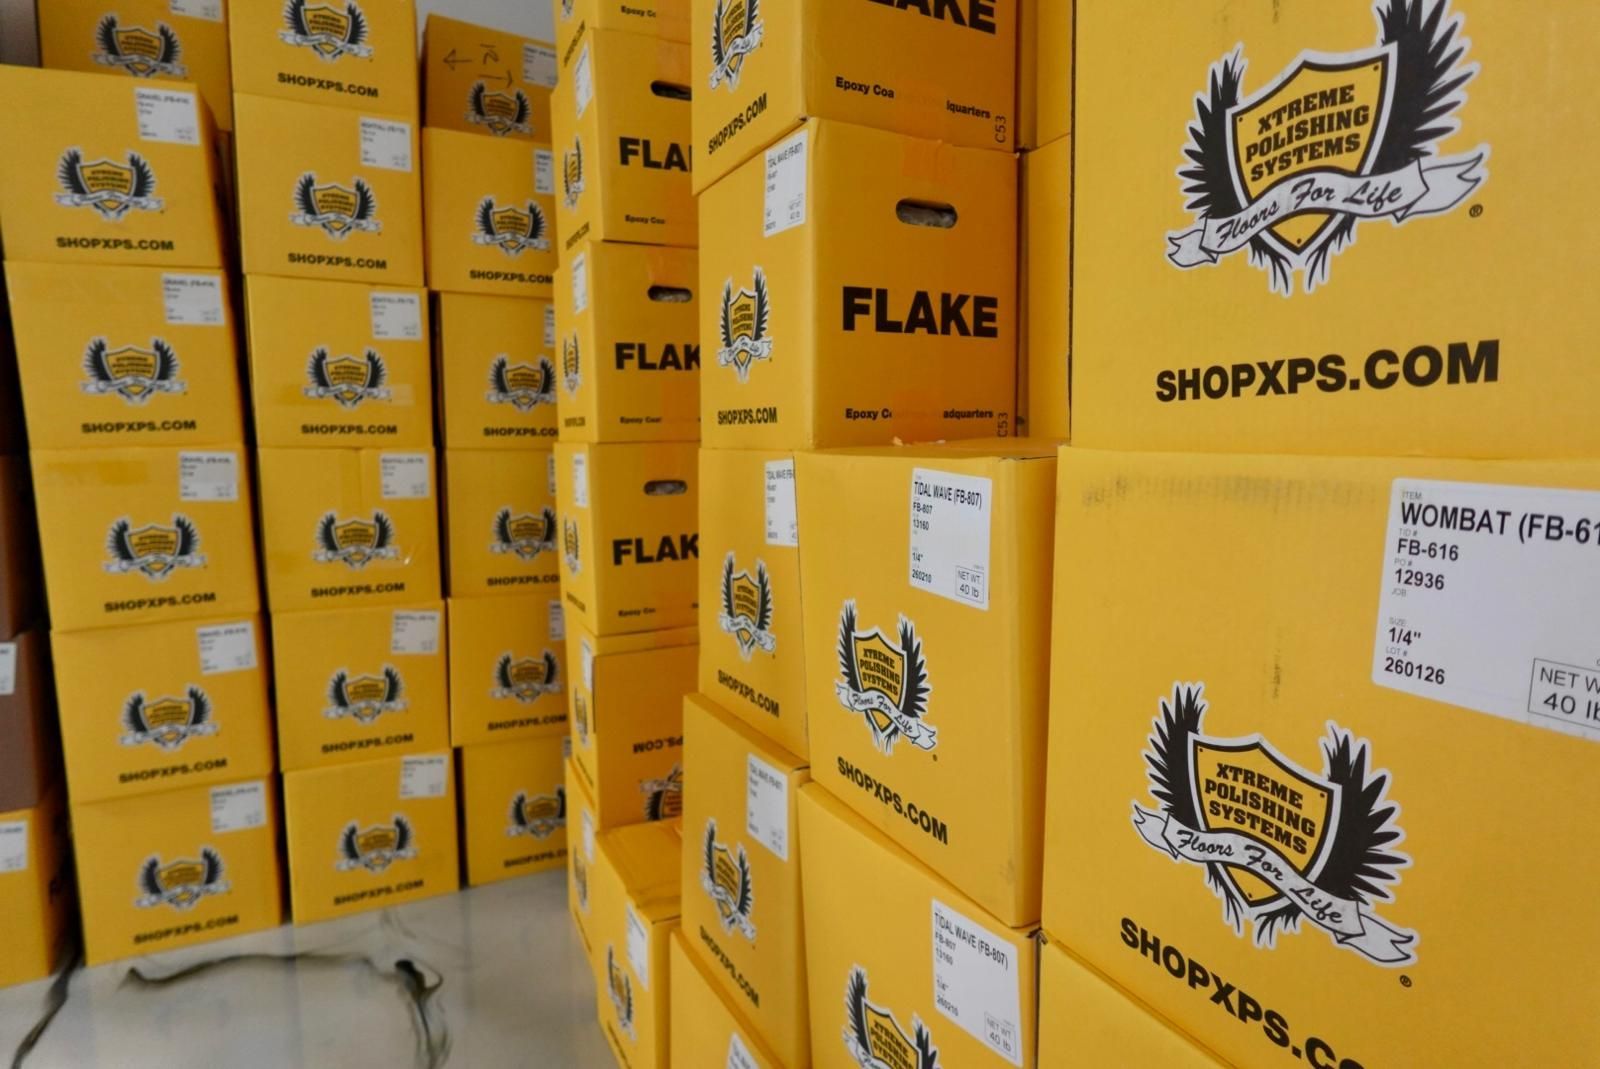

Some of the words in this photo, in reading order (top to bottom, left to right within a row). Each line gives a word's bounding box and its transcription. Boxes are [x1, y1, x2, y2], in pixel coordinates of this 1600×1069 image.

[277, 72, 379, 98] SHOPXPS.COM
[835, 76, 870, 95] Epoxy
[873, 84, 895, 99] Coa
[1257, 84, 1355, 135] XTREME
[708, 92, 767, 155] SHOPXPS.COM
[994, 115, 1007, 144] C53
[1245, 104, 1370, 163] POLISHING
[618, 136, 692, 172] FLA
[1250, 132, 1361, 182] SYSTEMS
[1215, 200, 1280, 248] Floors
[1290, 178, 1336, 210] For
[1342, 181, 1403, 212] Life
[56, 236, 174, 251] SHOPXPS.COM
[288, 252, 387, 270] SHOPXPS.COM
[842, 285, 998, 338] FLAKE
[615, 342, 701, 370] FLAK
[1155, 339, 1500, 402] SHOPXPS.COM
[82, 420, 196, 433] SHOPXPS.COM
[717, 407, 778, 425] SHOPXPS.COM
[845, 408, 879, 421] Epoxy
[943, 408, 994, 420] adquarters
[301, 424, 397, 436] SHOPXPS.COM
[913, 501, 933, 515] FB-807
[914, 481, 932, 498] TIDAL
[933, 484, 953, 502] WAVE
[953, 488, 983, 511] (FB-807)
[913, 519, 930, 531] 13160
[1401, 501, 1512, 536] WOMBAT
[612, 533, 699, 566] FLAK
[1394, 557, 1406, 567] PO
[1397, 537, 1460, 562] FB-616
[912, 568, 932, 584] 260210
[1394, 567, 1445, 591] 12936
[104, 592, 216, 613] SHOPXPS.COM
[310, 582, 405, 598] SHOPXPS.COM
[959, 583, 970, 595] 40
[971, 586, 979, 598] lb
[1388, 626, 1422, 646] 1/4"
[862, 648, 896, 669] XTREME
[1385, 646, 1401, 656] LOT
[859, 658, 901, 686] POLISHING
[862, 671, 899, 697] SYSTEMS
[1383, 656, 1446, 686] 260126
[1539, 666, 1580, 690] NET
[717, 668, 780, 718] SHOPXPS.COM
[1543, 692, 1576, 716] 40
[321, 733, 414, 754] SHOPXPS.COM
[119, 757, 228, 783] SHOPXPS.COM
[1216, 762, 1304, 810] XTREME
[837, 756, 948, 845] SHOPXPS.COM
[1204, 777, 1316, 838] POLISHING
[1208, 799, 1308, 855] SYSTEMS
[1176, 829, 1235, 858] Floors
[1244, 844, 1284, 882] For
[1289, 886, 1343, 925] Life
[333, 879, 424, 906] SHOPXPS.COM
[133, 914, 239, 945] SHOPXPS.COM
[934, 911, 954, 936] TIDAL
[954, 924, 976, 949] WAVE
[977, 939, 1008, 972] (FB-807)
[1120, 917, 1365, 1069] SHOPXPS.C
